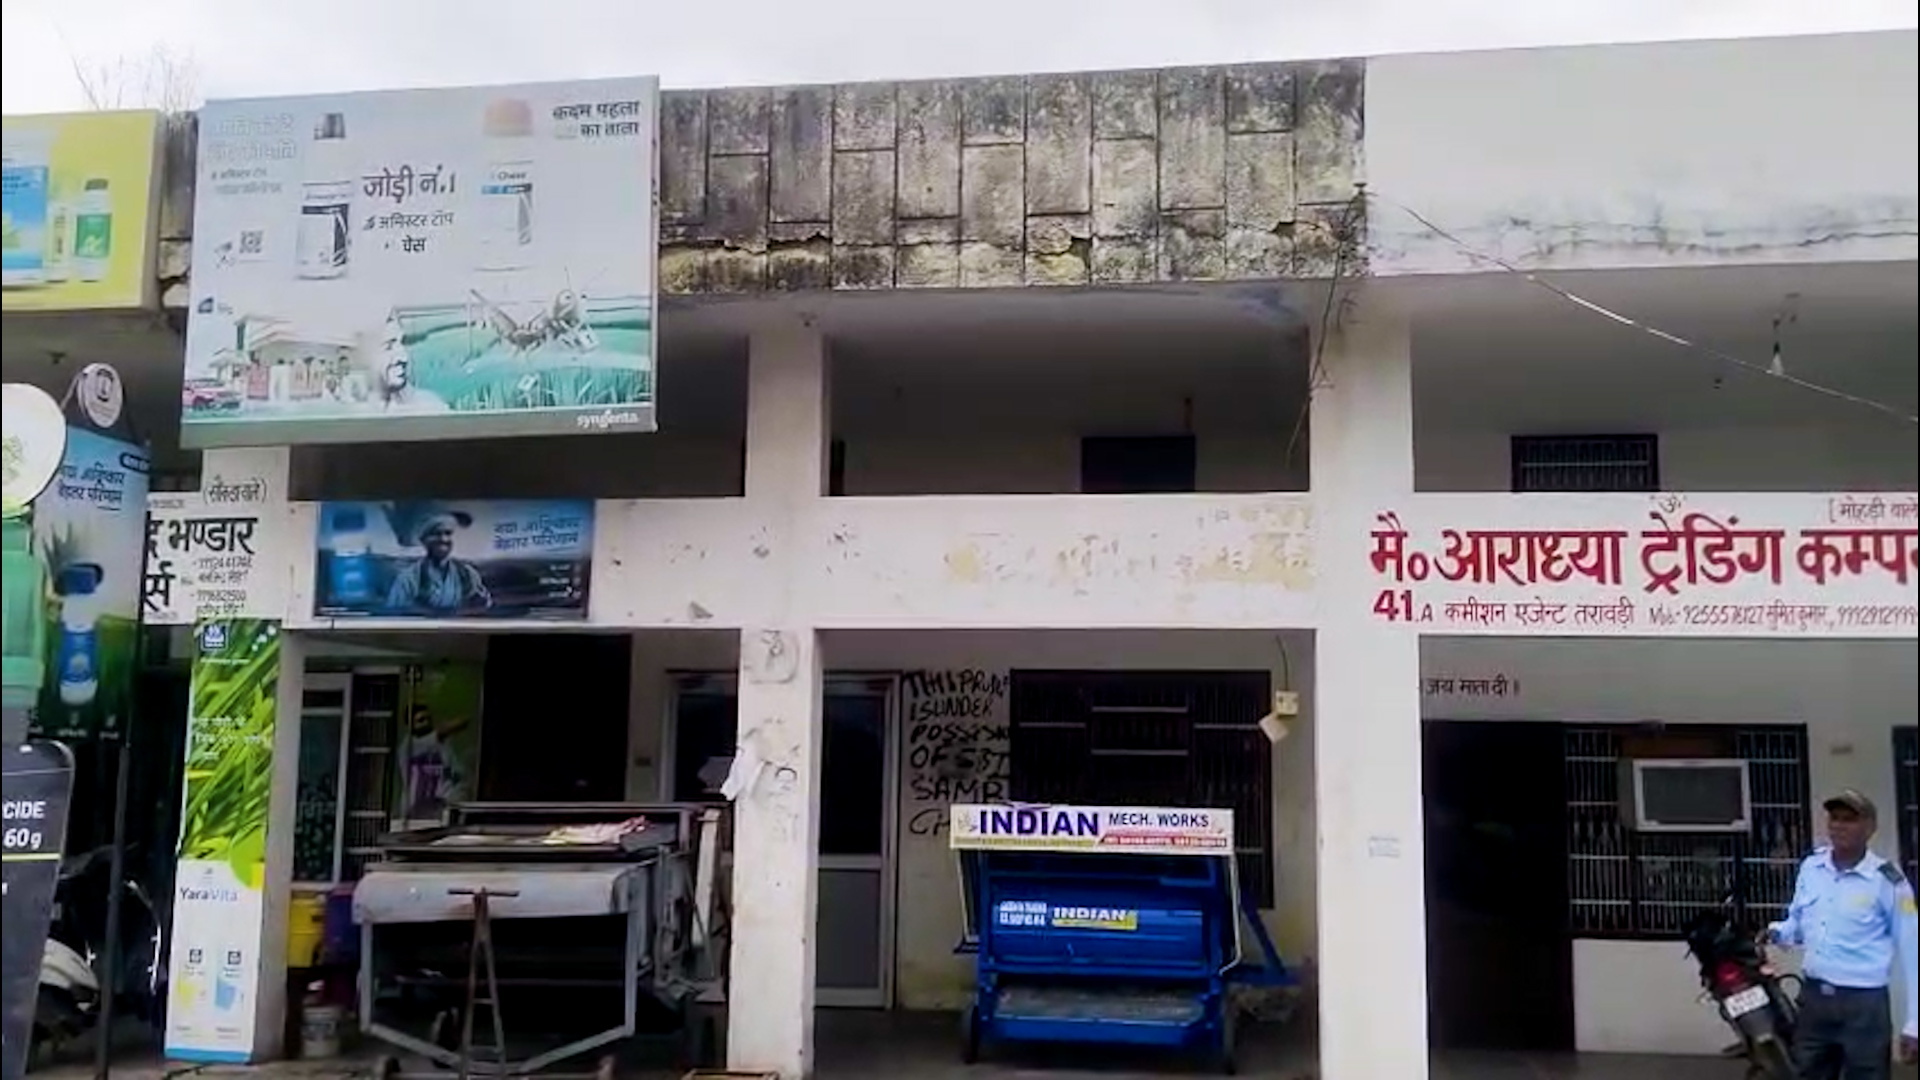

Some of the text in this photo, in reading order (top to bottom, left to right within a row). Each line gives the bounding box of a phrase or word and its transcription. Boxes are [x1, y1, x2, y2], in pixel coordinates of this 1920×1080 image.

[361, 164, 414, 203] जोड़ी
[577, 409, 638, 428] syngenta
[168, 516, 257, 554] भण्डार
[1434, 529, 1629, 586] आराध्या
[1641, 511, 1785, 595] ट्रेडिंग
[1797, 528, 1918, 586] कम्प
[1445, 596, 1507, 626] कमीशन
[1515, 596, 1568, 626] एजेन्ट
[1574, 596, 1635, 630] तरावड़ी
[1424, 678, 1454, 697] जय
[910, 744, 947, 769] OF
[978, 810, 1209, 837] INDIAN MECH. WORKS
[1053, 906, 1126, 922] INDIAN
